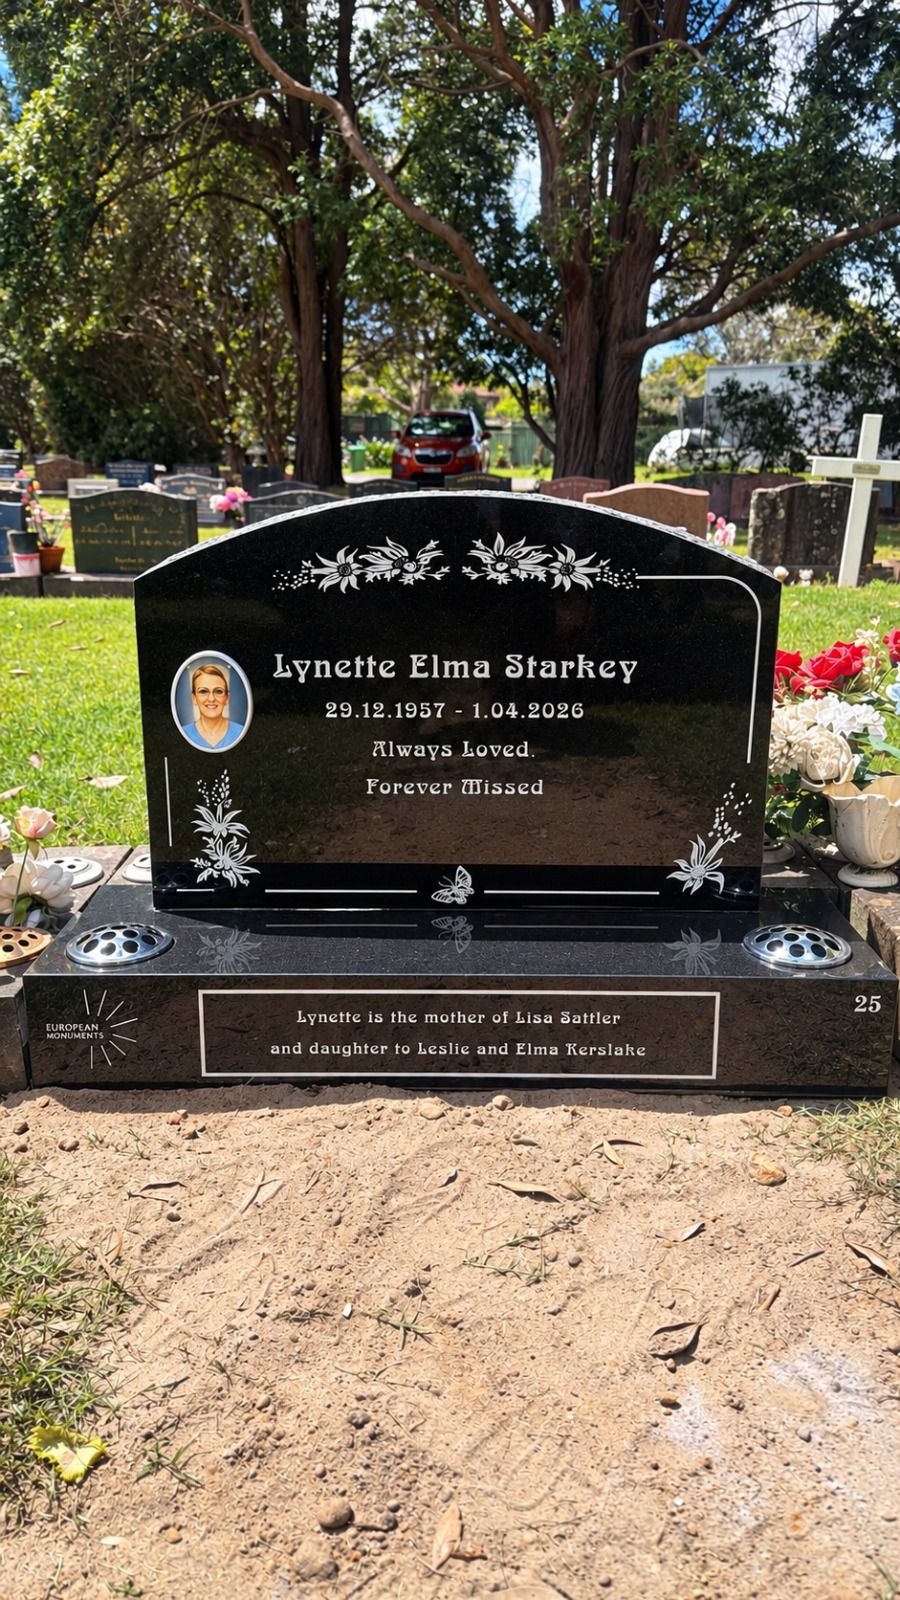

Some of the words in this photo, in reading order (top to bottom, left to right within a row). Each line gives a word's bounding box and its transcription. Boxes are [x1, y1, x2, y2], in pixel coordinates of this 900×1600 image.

[272, 653, 396, 684] Lynette
[409, 654, 491, 679] Elma
[505, 654, 638, 684] Starkey
[325, 701, 446, 719] 29.12.1957
[472, 702, 584, 719] 1.04.2026
[372, 740, 453, 761] Always
[461, 740, 535, 758] Loved.
[366, 778, 453, 795] Forever
[461, 778, 544, 795] Missed
[854, 994, 882, 1013] 25
[296, 1010, 361, 1026] Lynette
[368, 1010, 384, 1023] is
[390, 1010, 418, 1024] the
[424, 1011, 486, 1024] mother
[492, 1010, 509, 1024] of
[515, 1011, 553, 1024] Lisa
[560, 1011, 621, 1024] Sattler
[46, 1023, 99, 1032] EUROPEAN
[46, 1032, 105, 1040] MONUMENTS
[270, 1041, 302, 1055] and
[309, 1041, 388, 1058] daughter
[394, 1043, 411, 1055] to
[417, 1042, 470, 1055] Leslie
[476, 1042, 509, 1055] and
[515, 1042, 559, 1056] Elma
[565, 1042, 646, 1056] Kerslake
